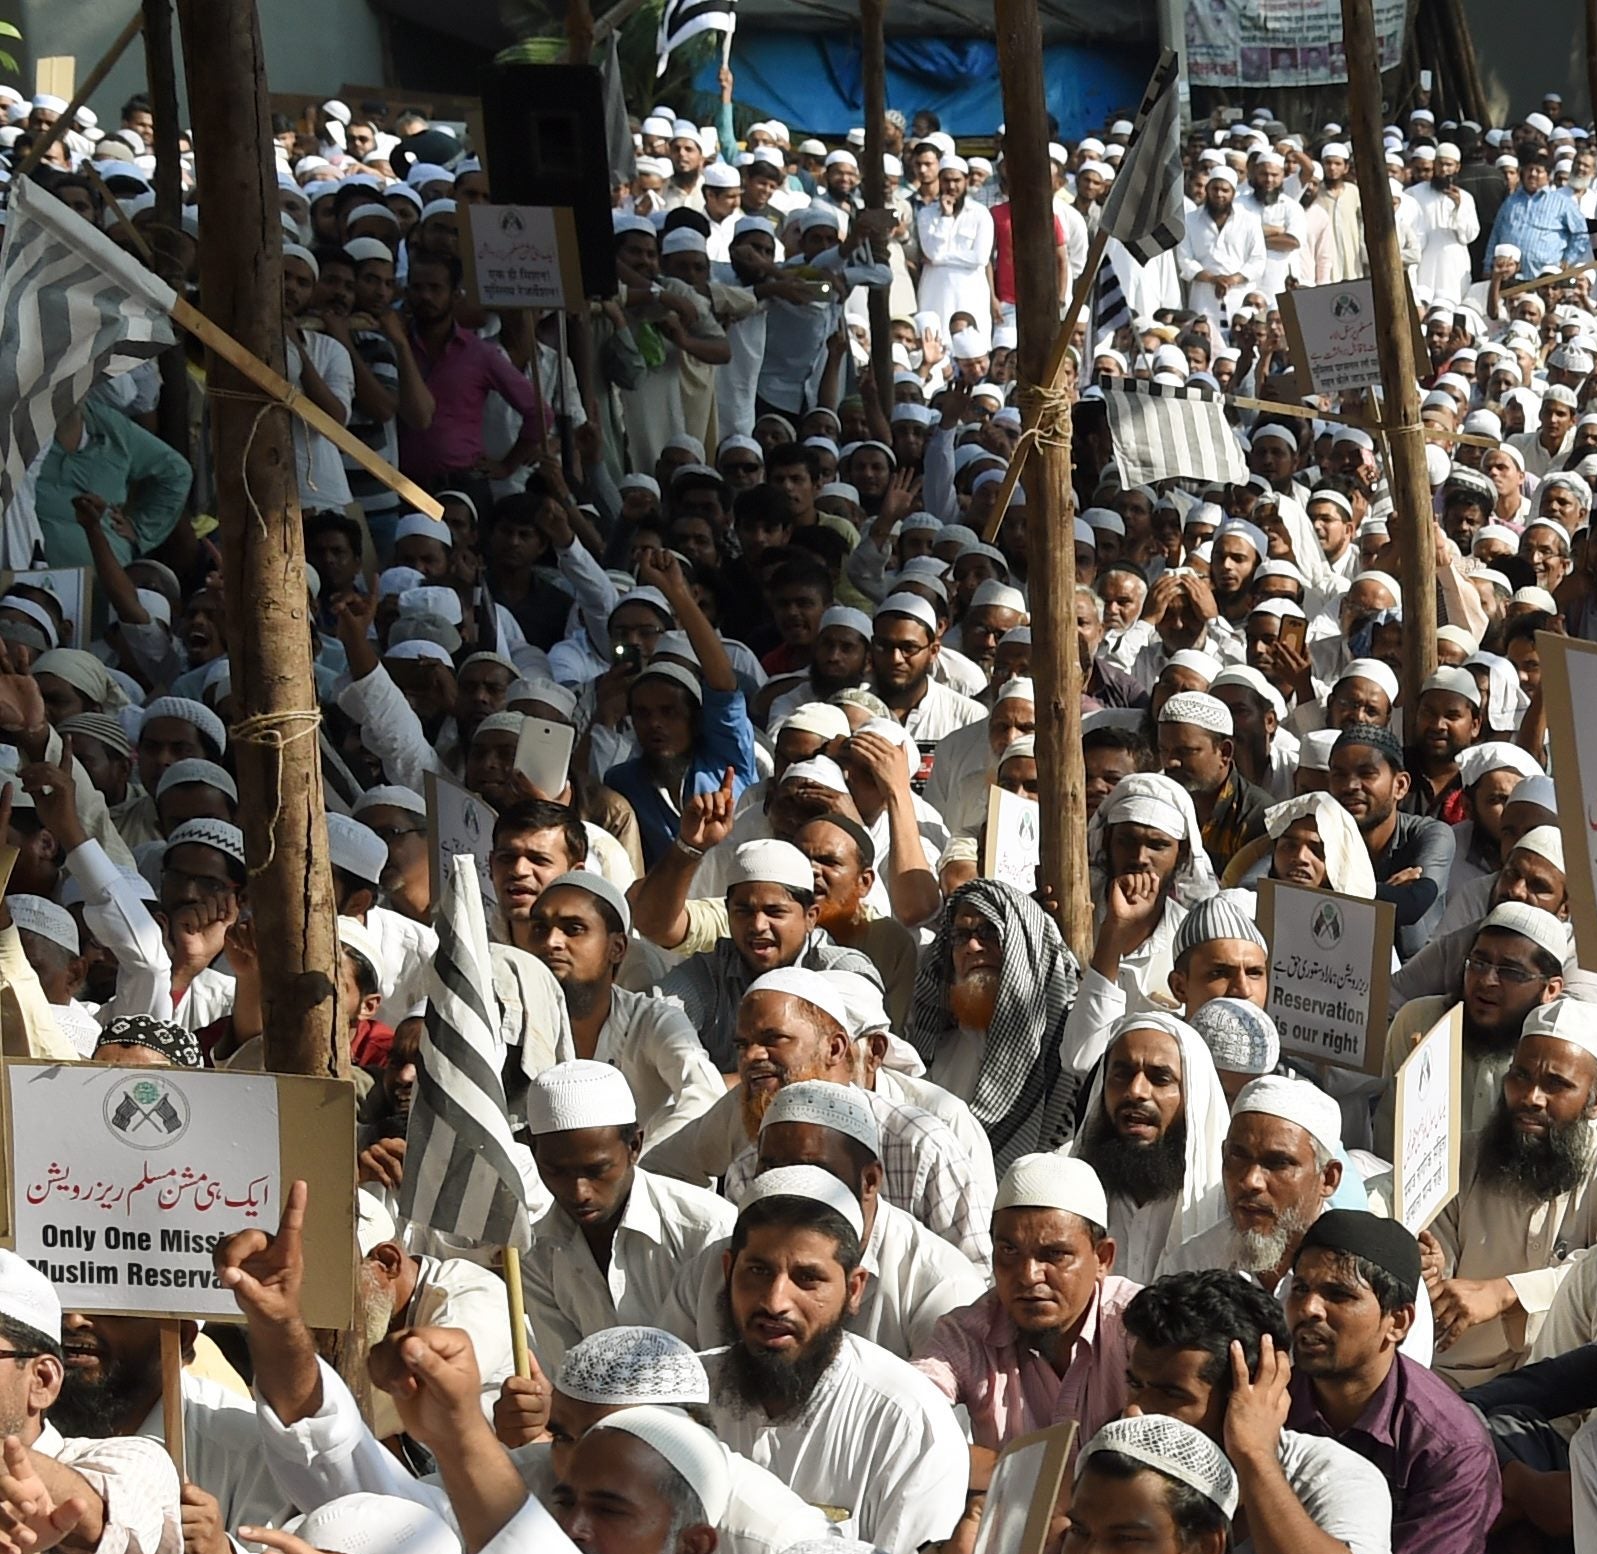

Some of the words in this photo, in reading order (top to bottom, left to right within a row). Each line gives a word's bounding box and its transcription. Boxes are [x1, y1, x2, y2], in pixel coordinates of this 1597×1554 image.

[1273, 985, 1364, 1026] Reservation
[1275, 1015, 1288, 1036] is
[1292, 1023, 1319, 1044] our
[1322, 1029, 1359, 1055] right
[26, 1162, 125, 1210] ریزرویشن
[126, 1160, 177, 1217] مسلم
[157, 1166, 209, 1210] مشن
[194, 1180, 222, 1212] ہی
[224, 1175, 269, 1217] ایک
[42, 1224, 96, 1252] Only
[104, 1226, 151, 1250] One
[127, 1266, 222, 1290] Reserva
